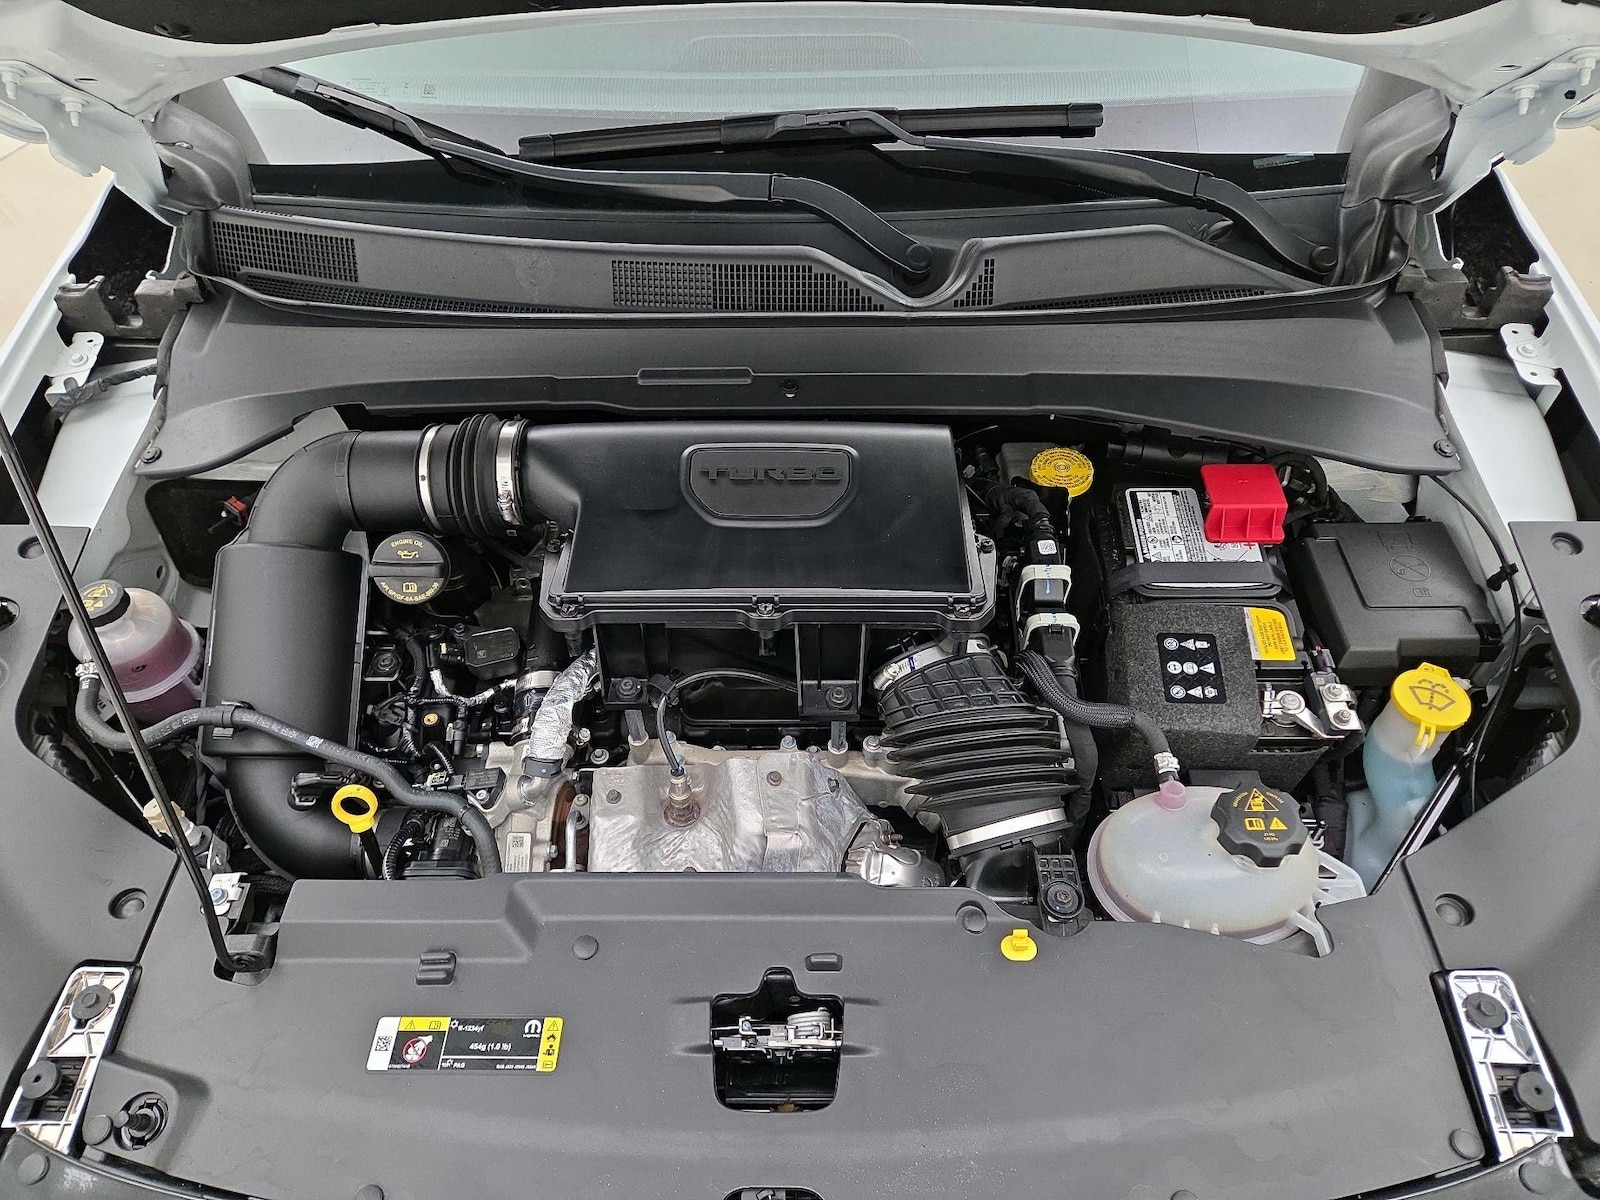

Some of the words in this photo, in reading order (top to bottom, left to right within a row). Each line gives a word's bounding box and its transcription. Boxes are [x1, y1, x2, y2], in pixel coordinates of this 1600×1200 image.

[700, 466, 843, 482] TURBO
[390, 538, 413, 548] ENGINE
[413, 539, 424, 549] OIL
[469, 1042, 487, 1052] 454g
[501, 1042, 512, 1052] lb)
